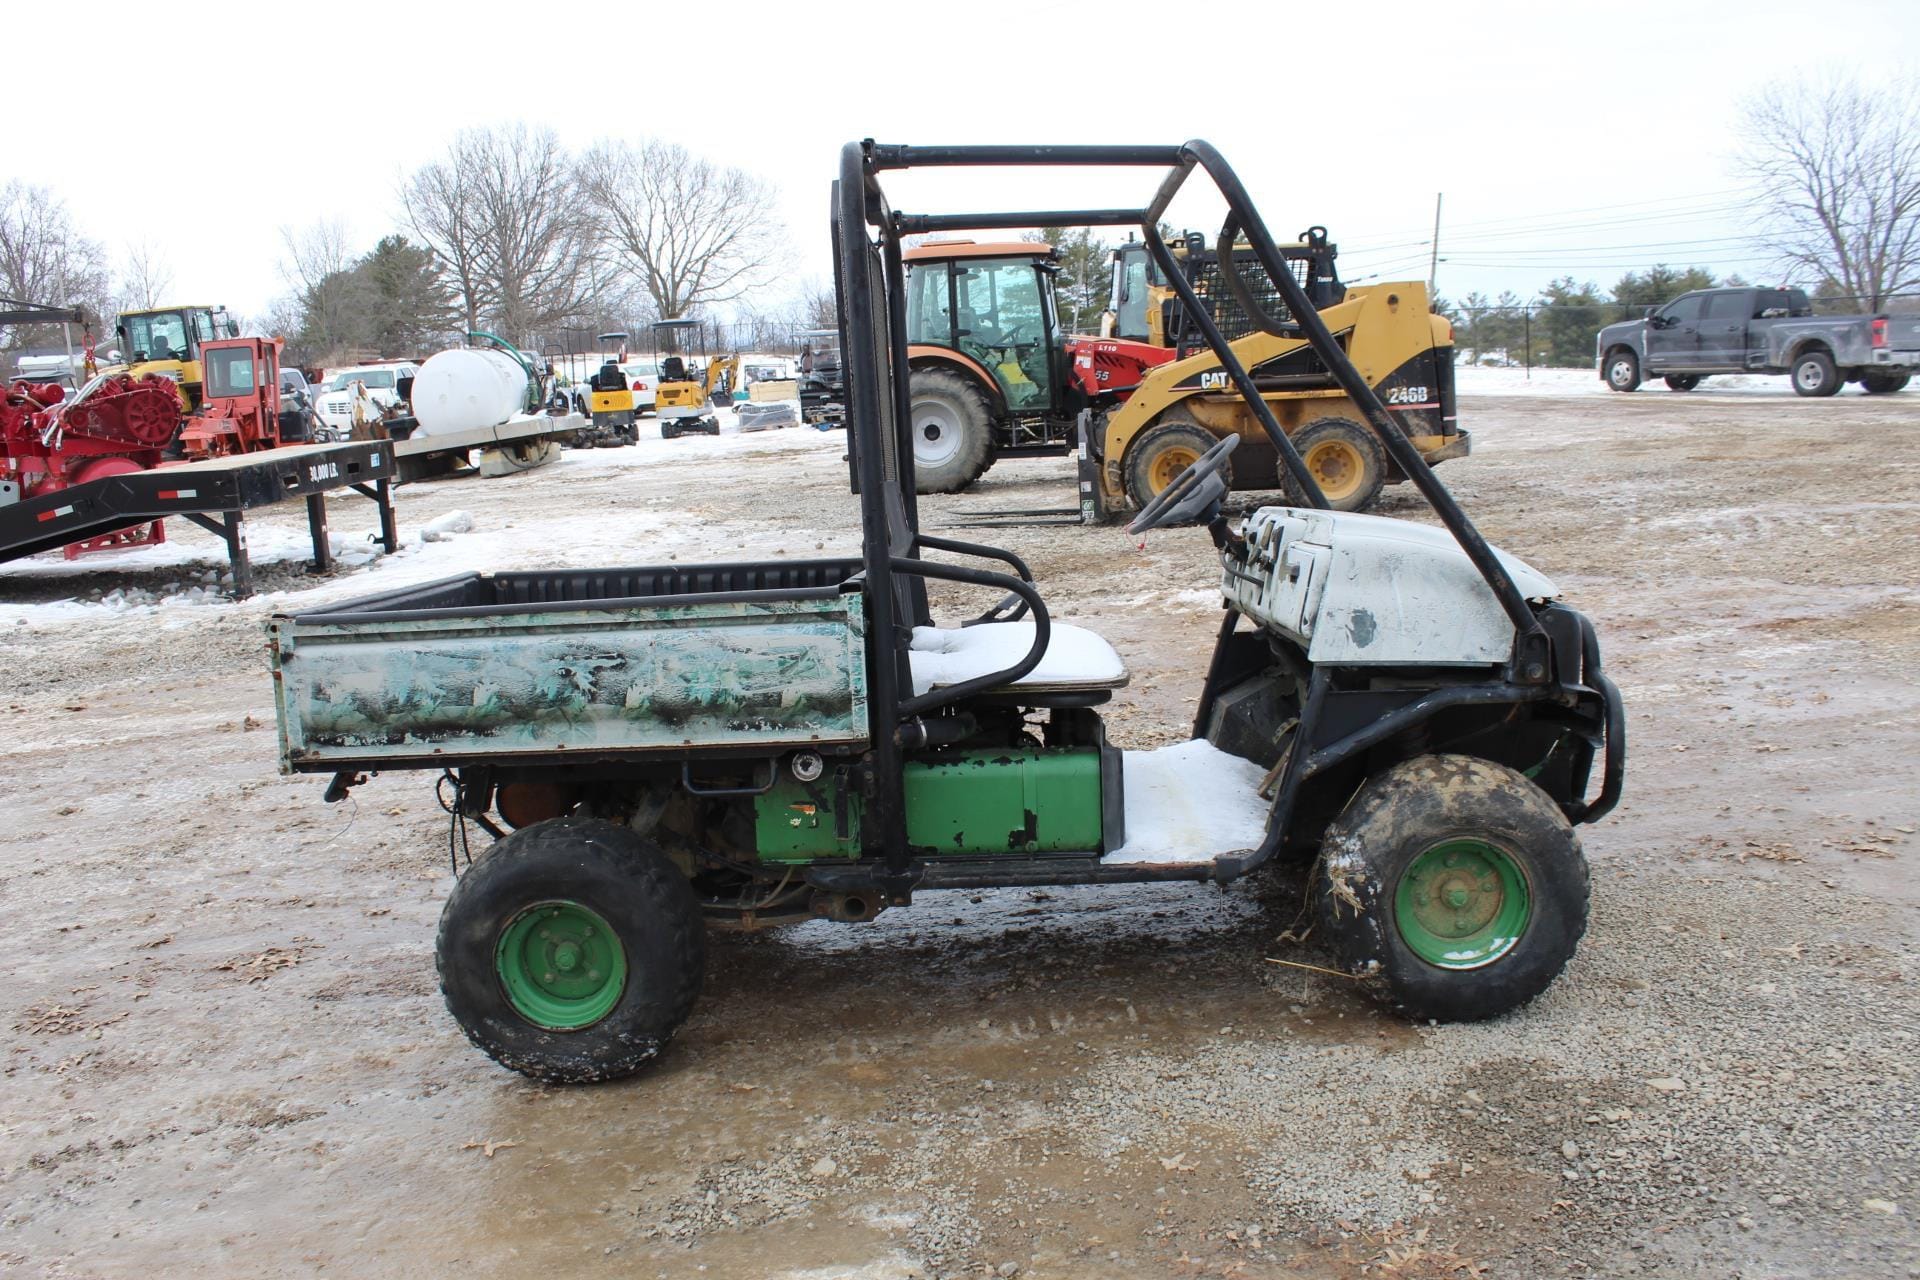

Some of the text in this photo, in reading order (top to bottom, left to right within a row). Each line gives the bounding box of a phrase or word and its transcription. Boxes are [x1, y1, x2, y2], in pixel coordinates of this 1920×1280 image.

[1098, 344, 1117, 352] L110
[1201, 371, 1228, 389] CAT
[1389, 386, 1428, 403] 246B
